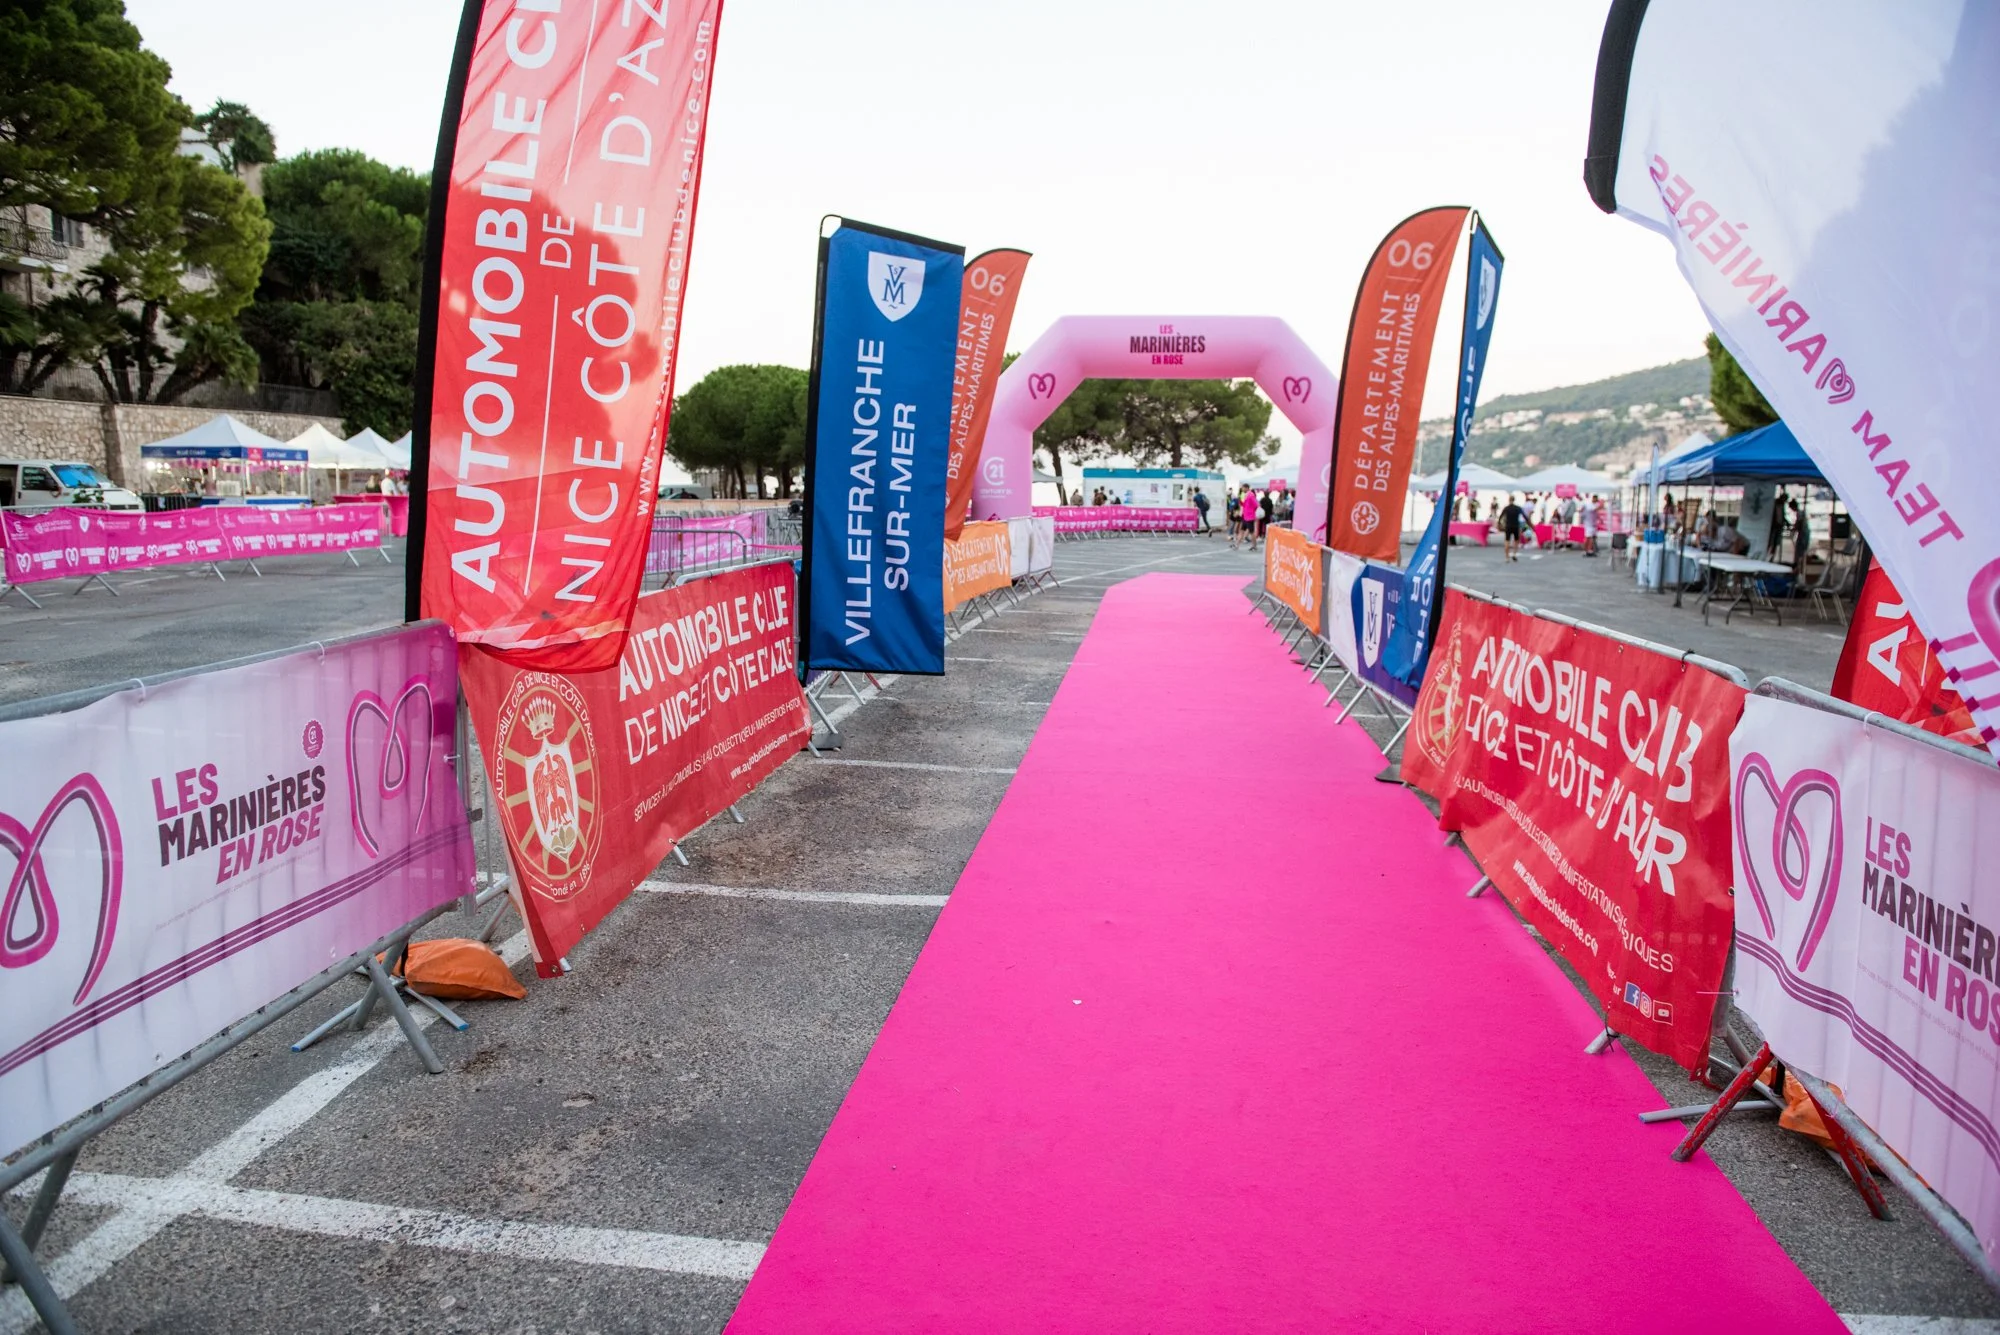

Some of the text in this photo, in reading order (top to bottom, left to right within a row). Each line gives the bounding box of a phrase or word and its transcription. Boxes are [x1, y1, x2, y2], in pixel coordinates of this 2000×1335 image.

[540, 213, 575, 269] DE
[970, 266, 1006, 296] 06
[1388, 239, 1434, 271] 06
[451, 92, 547, 593] AUTOMOBILE
[572, 202, 645, 403] CÔTE
[1130, 331, 1206, 353] MARINIÈRES
[1160, 324, 1174, 334] LES
[955, 313, 995, 447] ALPES-MARITIMES
[1152, 354, 1184, 365] EN ROSE
[1355, 290, 1400, 490] DÉPARTEMENT
[1373, 292, 1421, 492] DES ALPES-MARITIMES
[555, 437, 624, 603] NICE
[845, 338, 884, 647] VILLEFRANCHE
[883, 402, 917, 590] SUR-MER
[619, 596, 751, 703] AUTOMOBILE
[495, 706, 515, 801] AUTOMOBILE
[625, 709, 658, 765] DE
[660, 683, 700, 745] NICE
[1515, 724, 1550, 775] ET
[1547, 738, 1604, 819] CÔTE
[151, 763, 219, 821] LES
[159, 764, 326, 867] MARINIÈRES
[216, 803, 325, 885] EN ROSE
[1864, 816, 1912, 880] LES
[1903, 935, 1940, 1002] EN
